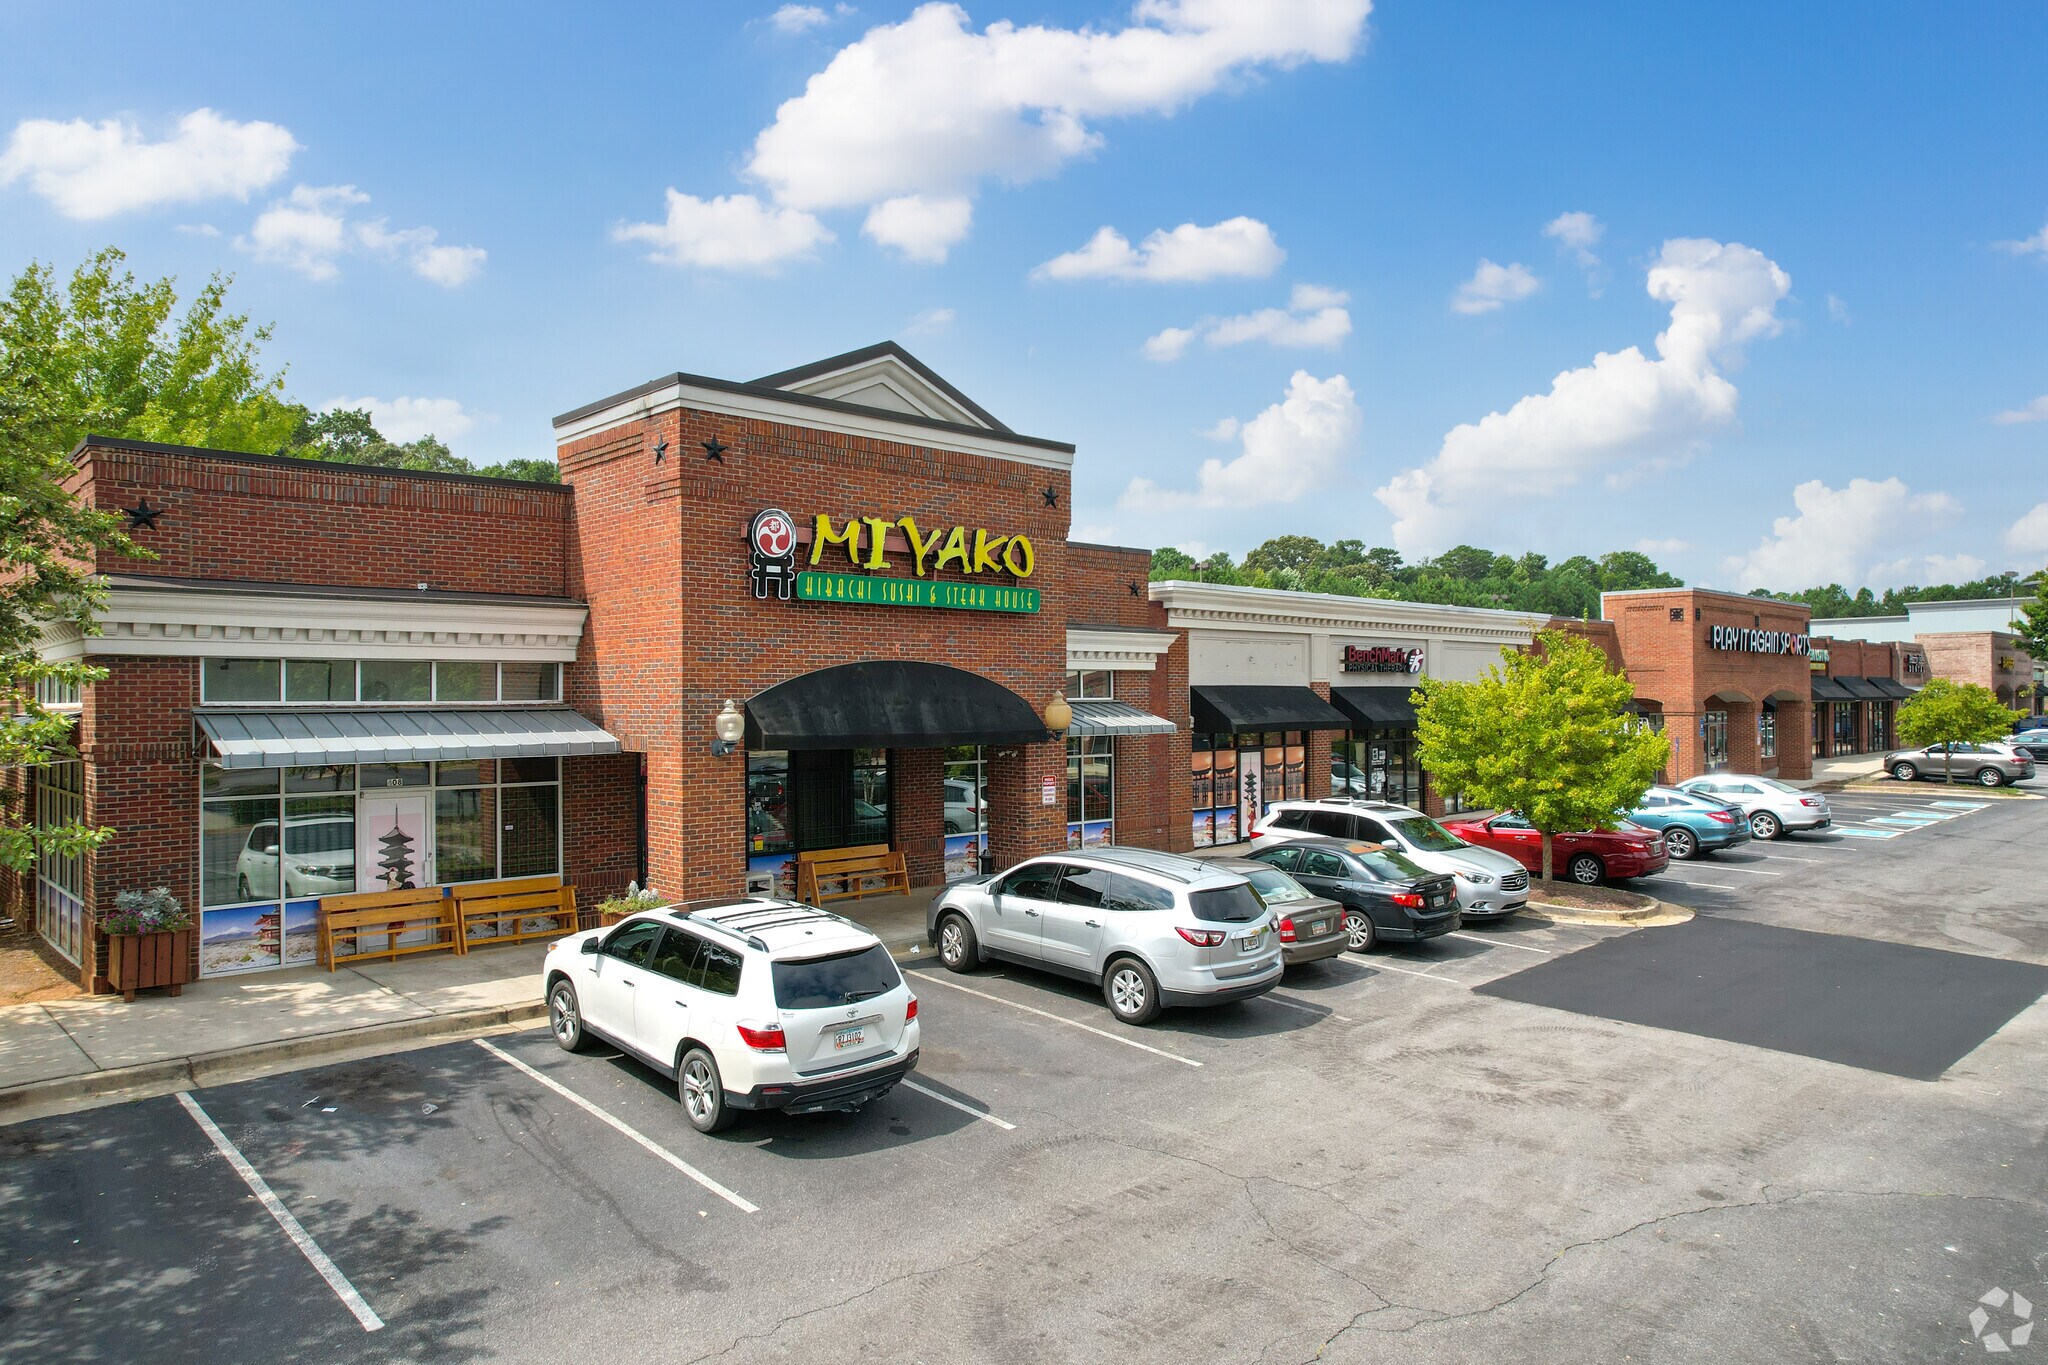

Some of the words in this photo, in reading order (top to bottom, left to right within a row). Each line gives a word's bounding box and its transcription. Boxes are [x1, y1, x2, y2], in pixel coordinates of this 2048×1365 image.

[809, 514, 1035, 577] MIYAKO
[806, 576, 871, 600] HIBACHI
[883, 582, 920, 603] SUSHI
[930, 585, 937, 604] &
[946, 586, 985, 607] STEAK
[995, 590, 1033, 609] HOUSE
[1348, 645, 1407, 663] BenchMark
[1713, 625, 1739, 650] PLAY
[1740, 628, 1750, 652] IT
[1750, 629, 1779, 653] AGAIN
[1780, 632, 1811, 656] SPORTS
[1349, 663, 1378, 672] PHYSICAL
[1380, 664, 1407, 672] THERAPY
